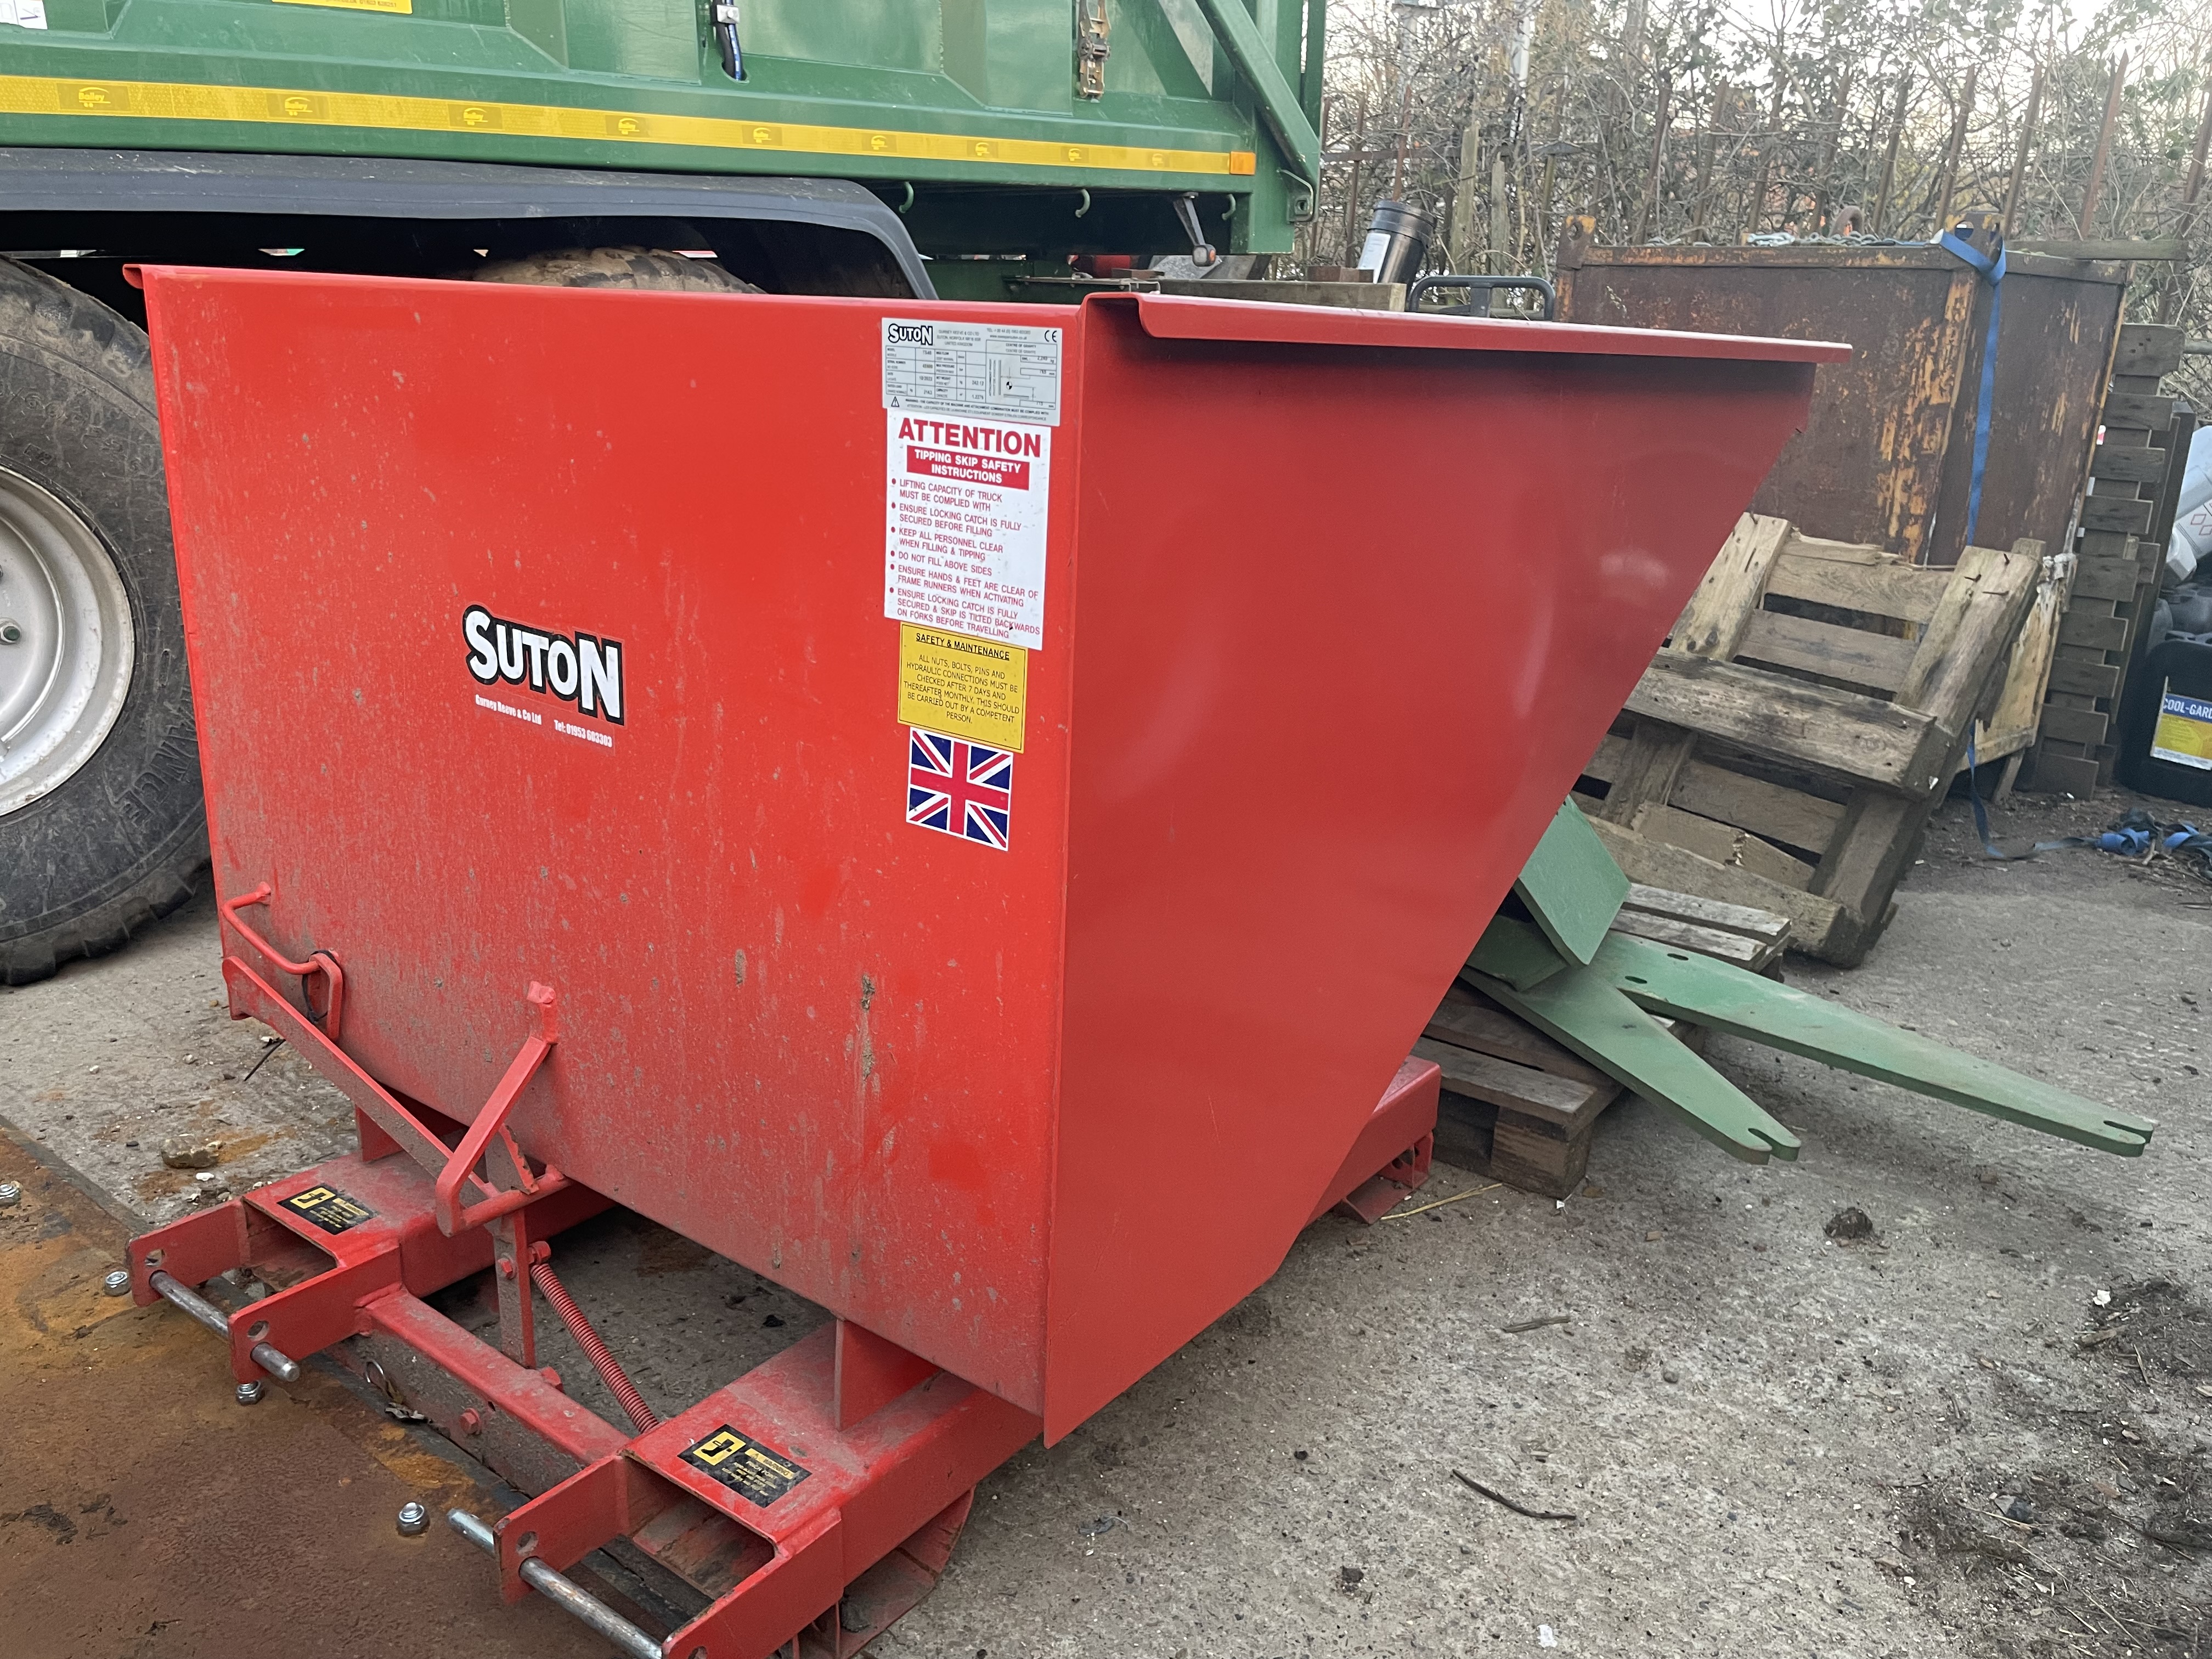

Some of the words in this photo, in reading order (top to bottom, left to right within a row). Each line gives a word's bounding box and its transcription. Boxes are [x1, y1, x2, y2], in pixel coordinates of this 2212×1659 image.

[889, 324, 933, 345] SUTON
[899, 417, 1041, 458] ATTENTION
[915, 449, 951, 463] TIPPING
[955, 455, 978, 466] SKIP
[981, 459, 1021, 473] SAFETY
[932, 464, 1002, 483] INSTRUCTIONS
[900, 479, 925, 490] LIFTING
[928, 483, 962, 496] CAPACITY
[966, 489, 975, 498] OF
[978, 491, 1002, 503] TRUCK
[900, 489, 919, 499] MUST
[922, 493, 930, 501] BE
[934, 495, 969, 508] COMPLIED
[973, 501, 990, 511] WITH
[900, 503, 927, 515] ENSURE
[930, 508, 961, 521] LOCKING
[964, 514, 988, 526] CATCH
[990, 518, 997, 527] IS
[1001, 520, 1022, 531] FULLY
[900, 514, 932, 526] SECURED
[935, 520, 963, 532] BEFORE
[966, 525, 992, 537] FILLING
[899, 527, 917, 537] KEEP
[919, 531, 932, 540] ALL
[934, 533, 977, 549] PERSONNEL
[979, 542, 1003, 553] CLEAR
[899, 538, 919, 549] WHEN
[922, 542, 947, 554] FILLING
[950, 547, 955, 555] &
[958, 549, 985, 561] TIPPING
[899, 551, 909, 560] DO
[911, 554, 926, 563] NOT
[928, 556, 943, 566] FILL
[944, 560, 968, 572] ABOVE
[971, 565, 992, 575] SIDES
[897, 575, 921, 586] FRAME
[924, 580, 957, 594] RUNNERS
[960, 587, 980, 599] WHEN
[983, 592, 1023, 607] ACTIVATING
[899, 565, 926, 577] ENSURE
[929, 571, 952, 582] HANDS
[964, 577, 981, 588] FEET
[984, 582, 998, 591] ARE
[1002, 585, 1025, 597] CLEAR
[1028, 590, 1038, 599] OF
[898, 588, 925, 600] ENSURE
[928, 594, 958, 607] LOCKING
[962, 601, 984, 613] CATCH
[988, 606, 994, 614] IS
[997, 608, 1018, 619] FULLY
[898, 598, 930, 611] SECURED
[941, 607, 956, 617] SKIP
[960, 611, 966, 619] IS
[969, 612, 992, 624] TILTED
[995, 618, 1040, 635] BACKWARDS
[898, 608, 907, 617] ON
[910, 611, 933, 622] FORKS
[936, 616, 964, 629] BEFORE
[967, 622, 1011, 639] TRAVELLING
[916, 633, 945, 645] SAFETY
[955, 641, 1009, 659] MAINTENANCE
[463, 606, 624, 725] SUTON
[907, 662, 941, 675] HYDRAULIC
[943, 670, 988, 686] CONNECTIONS
[990, 680, 1008, 690] MUST
[1010, 685, 1018, 693] BE
[919, 654, 929, 663] ALL
[932, 657, 949, 668] NUTS,
[952, 662, 972, 673] BOLTS,
[975, 667, 989, 676] PINS
[992, 670, 1005, 679] AND
[904, 681, 941, 697] THEREAFTER
[944, 690, 974, 703] MONTHLY.
[977, 698, 991, 707] THIS
[994, 702, 1019, 714] SHOULD
[917, 674, 945, 686] CHECKED
[947, 681, 966, 692] AFTER
[974, 687, 990, 697] DAYS
[992, 691, 1006, 700] AND
[475, 694, 497, 711] Gurney
[497, 701, 516, 717] Reeve
[517, 709, 521, 718] &
[522, 709, 531, 721] Co
[532, 712, 542, 725] Ltd
[554, 720, 565, 733] Tel:
[566, 723, 586, 740] 01953
[587, 729, 612, 747] 603303
[917, 695, 943, 706] CARRIED
[945, 701, 958, 710] OUT
[977, 708, 1014, 723] COMPETENT
[947, 712, 972, 724] PERSON.
